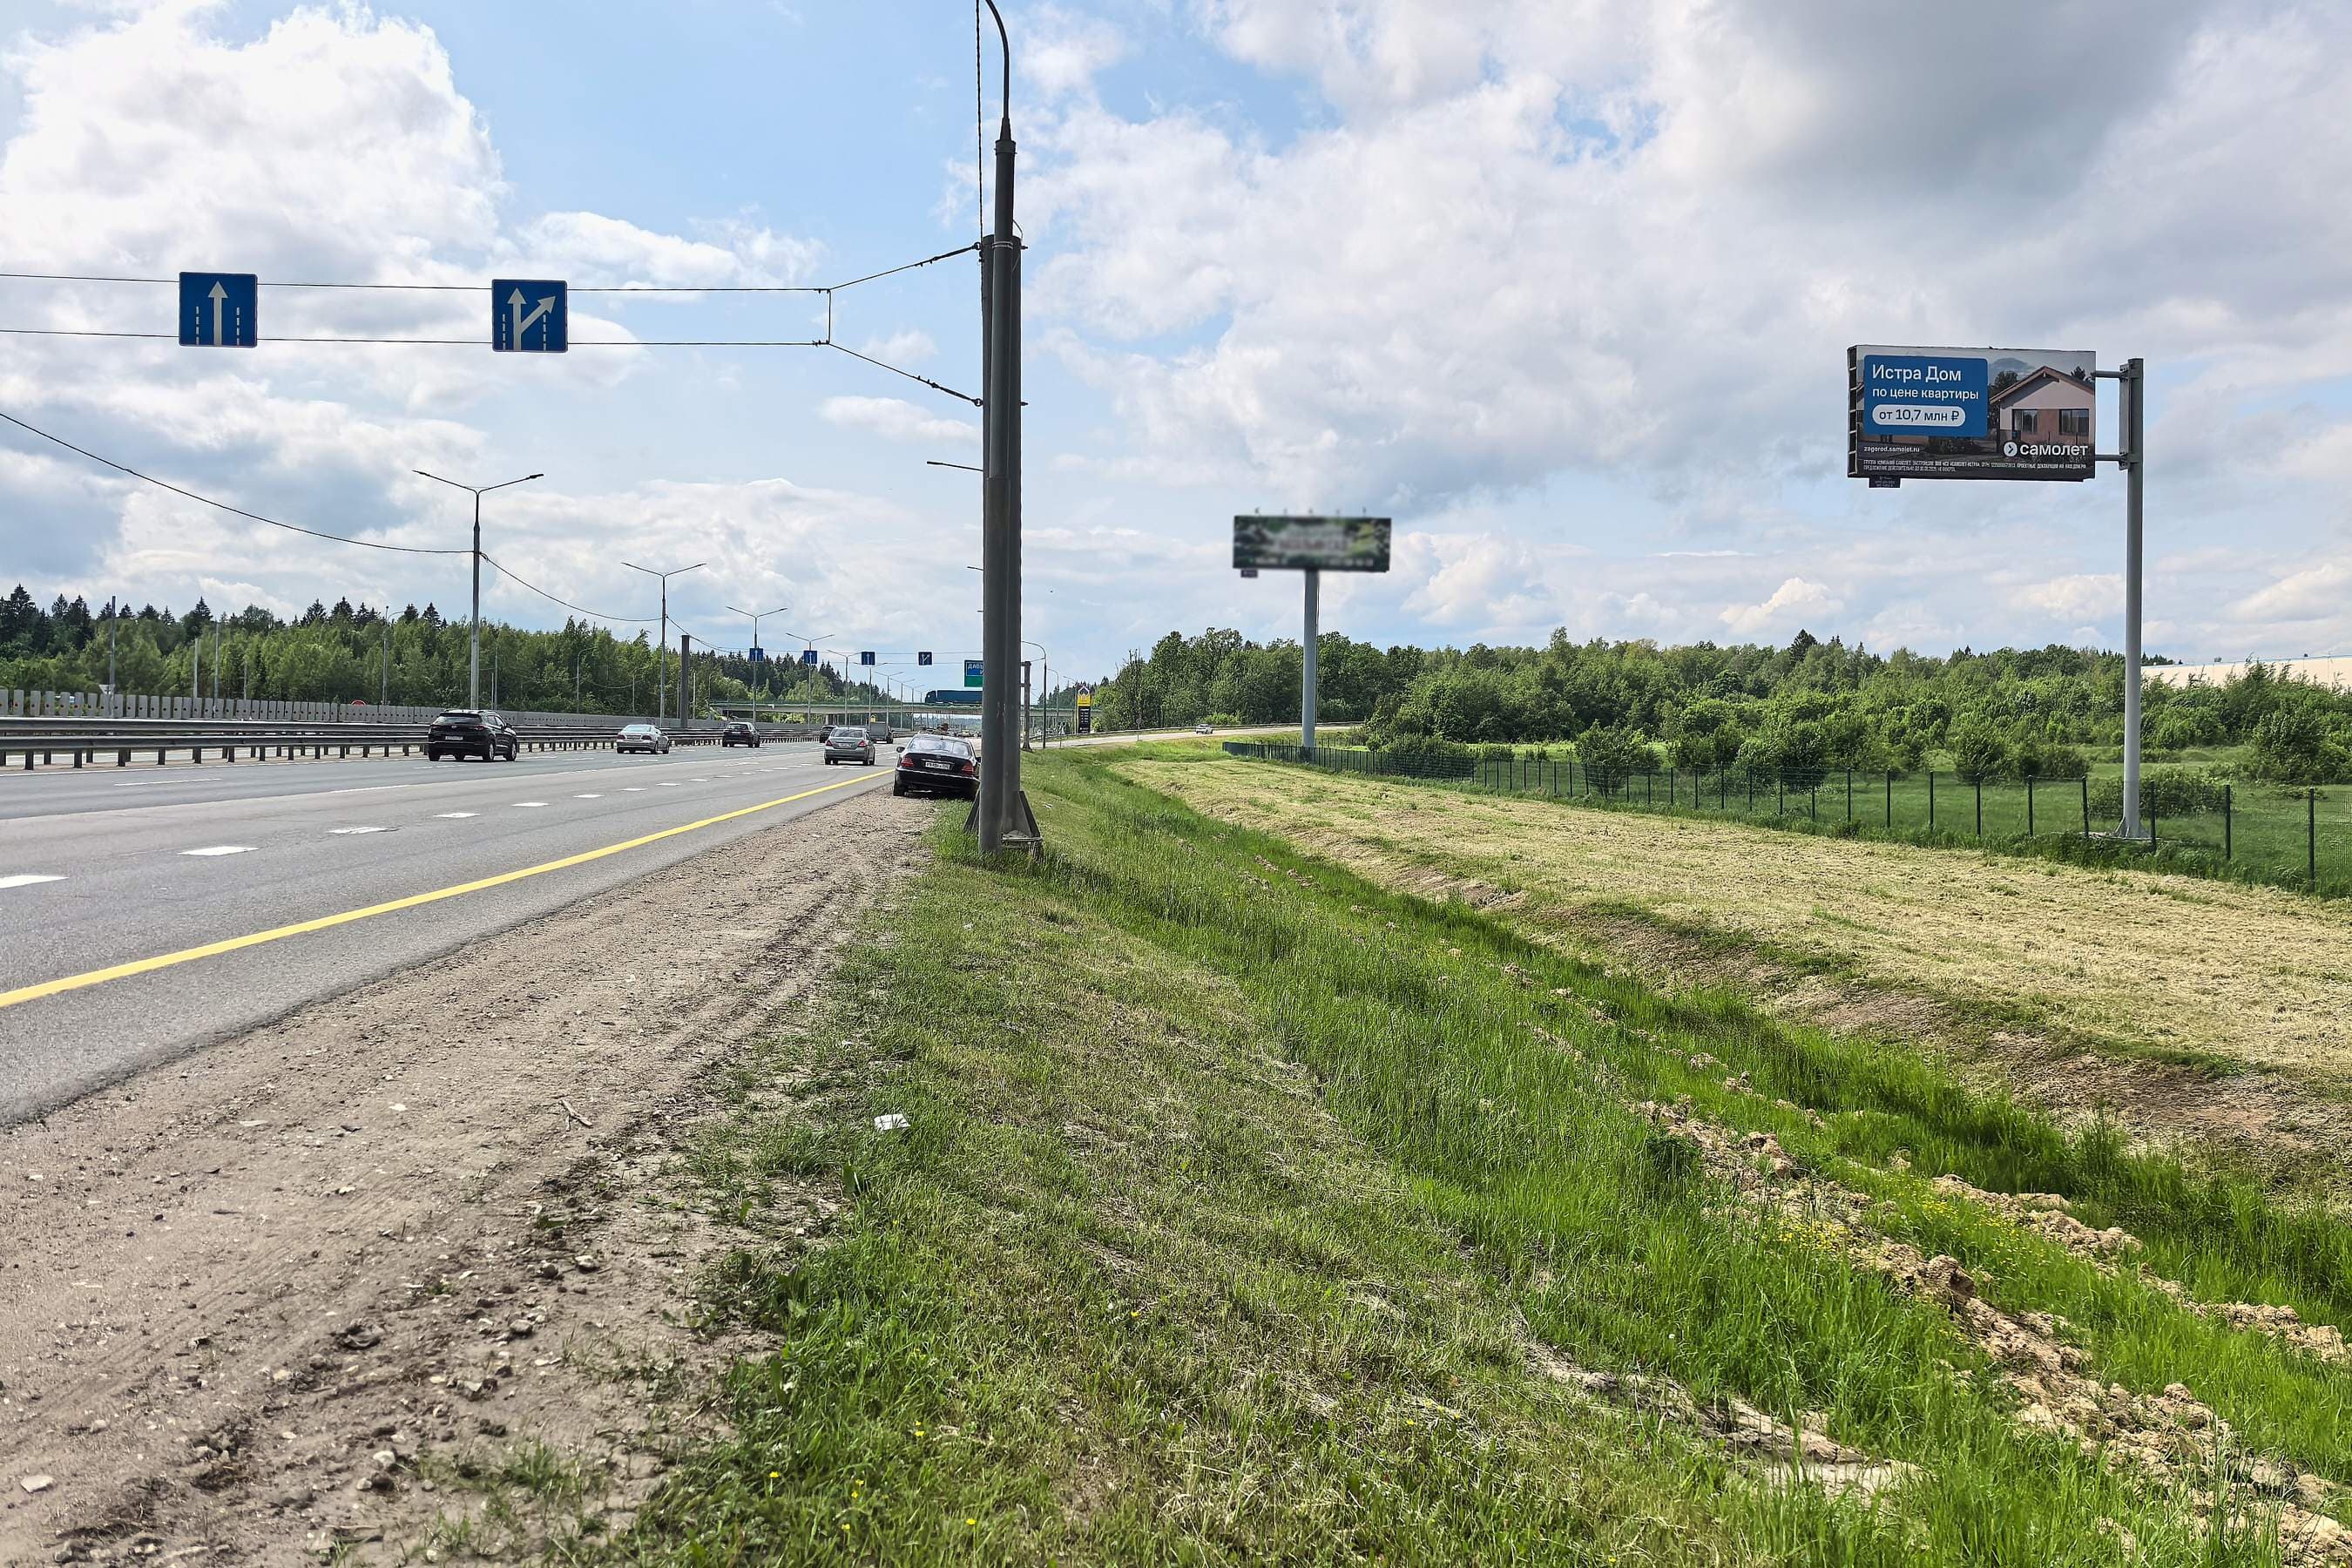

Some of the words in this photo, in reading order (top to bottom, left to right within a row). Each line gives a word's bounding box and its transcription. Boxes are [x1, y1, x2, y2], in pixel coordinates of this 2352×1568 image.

[1872, 364, 1922, 383] Истра
[1925, 366, 1962, 383] Дом
[1872, 389, 1888, 397] по
[1890, 389, 1918, 399] цене
[1922, 389, 1979, 402] квартиры
[1879, 411, 1893, 420] от
[1896, 409, 1922, 422] 10,7
[1924, 412, 1948, 421] млн
[2020, 444, 2089, 456] самолет
